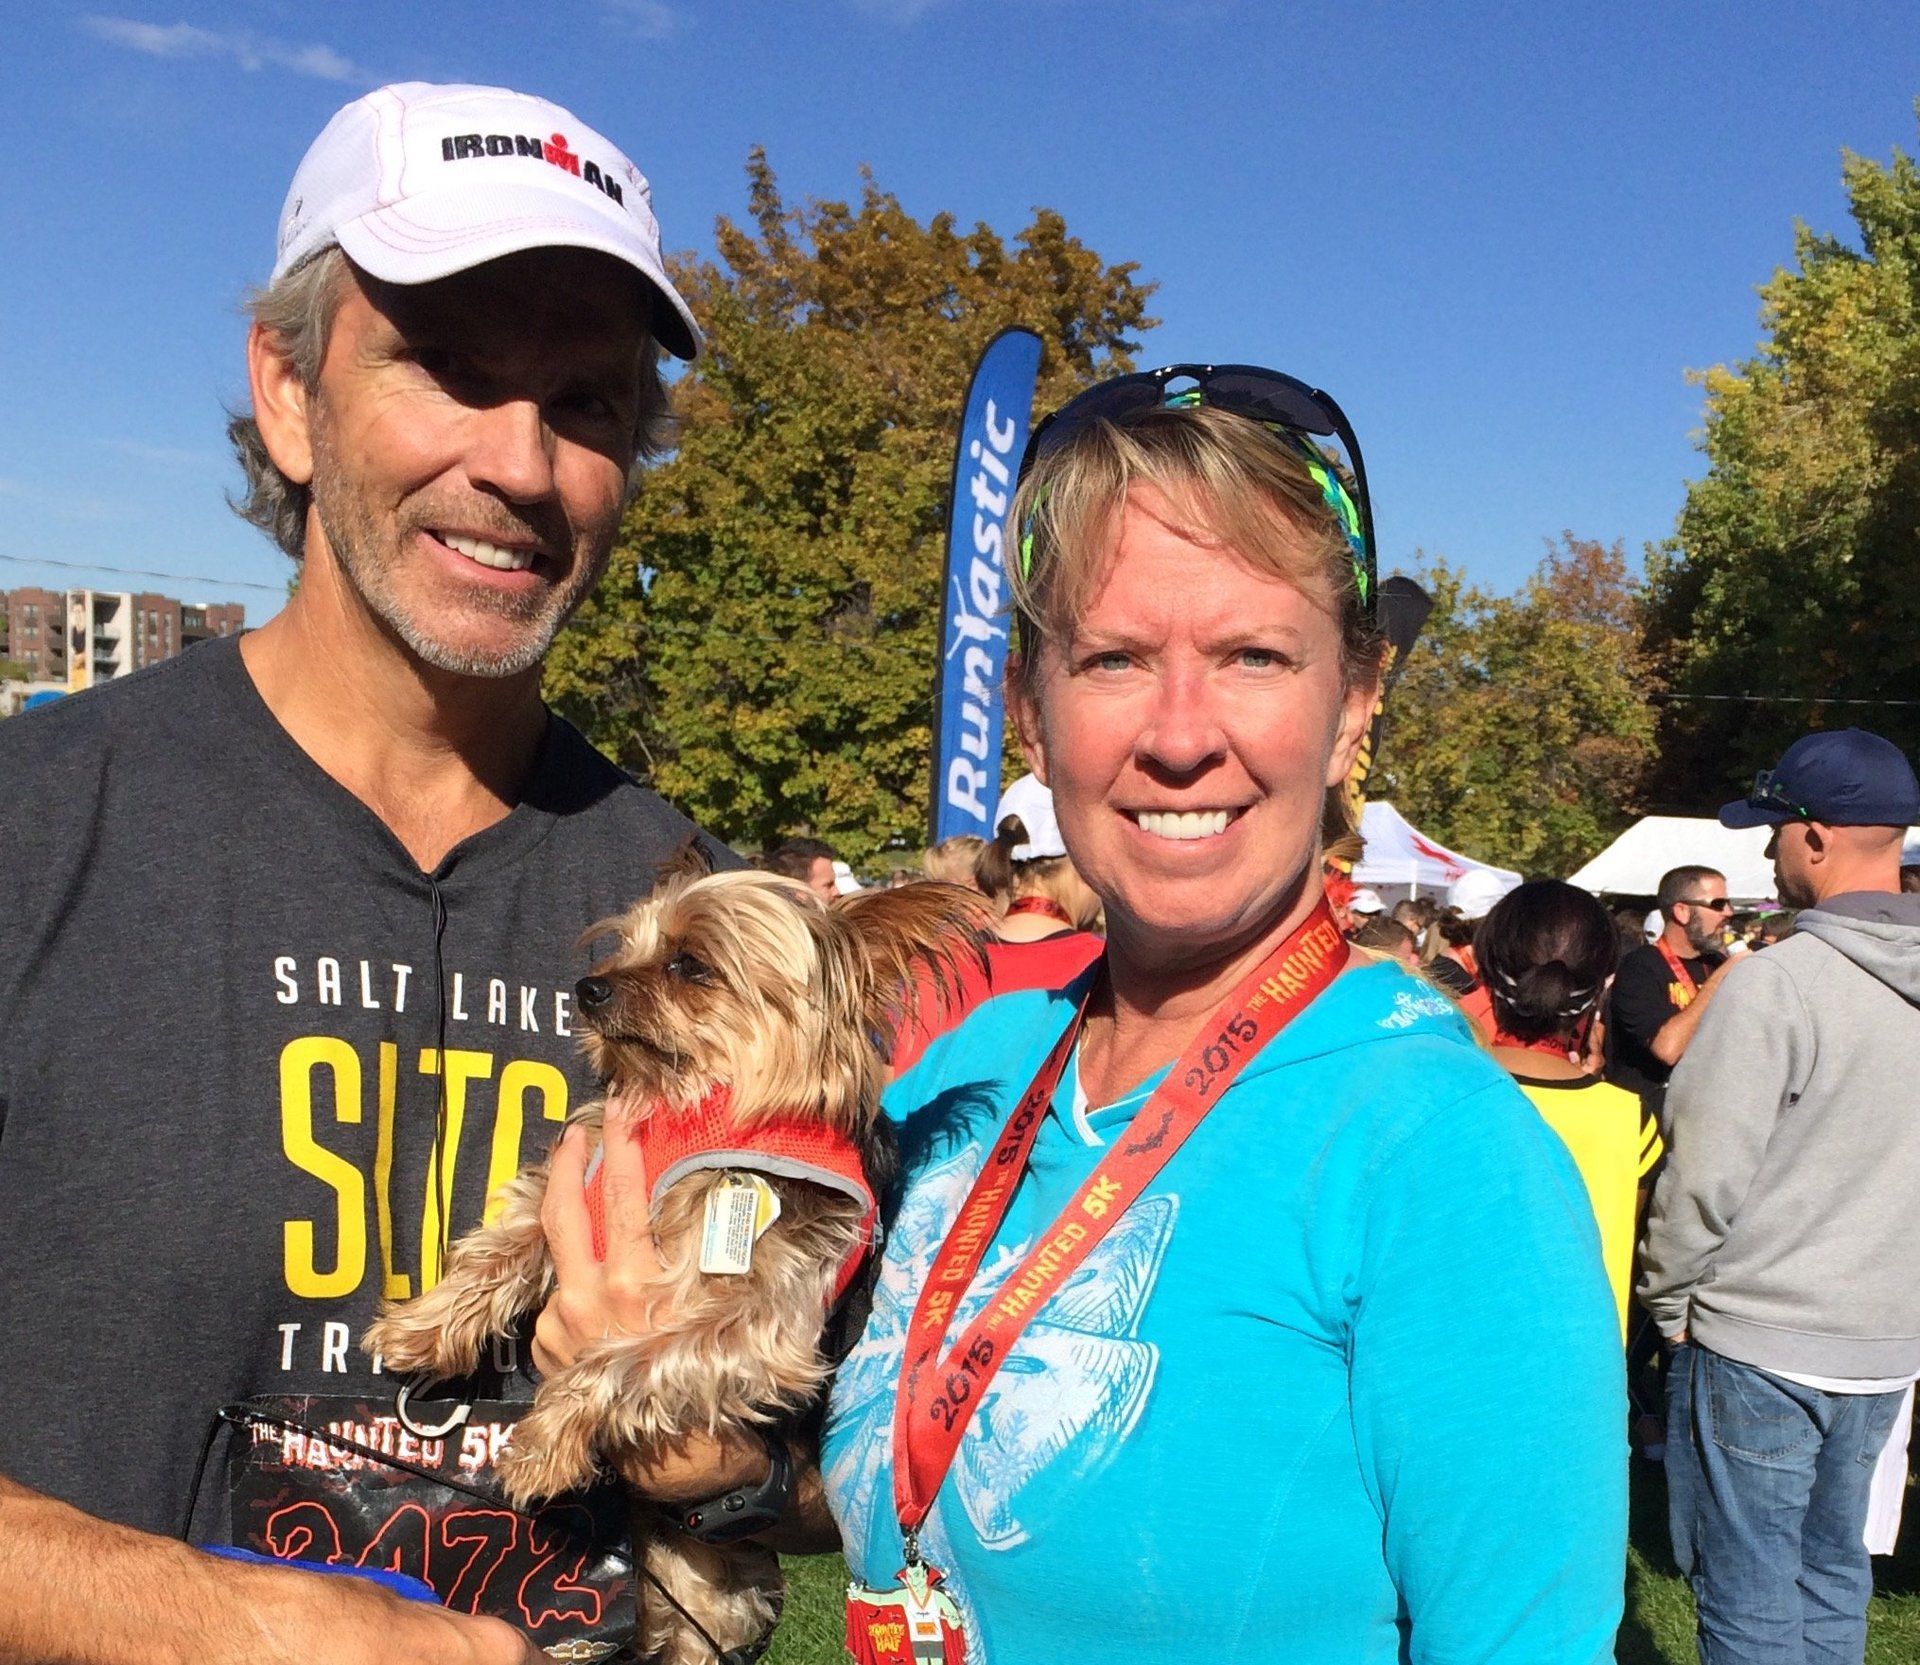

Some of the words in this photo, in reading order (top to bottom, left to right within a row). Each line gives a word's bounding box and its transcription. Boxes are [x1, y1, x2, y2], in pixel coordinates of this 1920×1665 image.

[442, 133, 624, 207] IRONMAN
[275, 956, 412, 1013] SALT
[453, 973, 571, 1037] LAKE
[1185, 1012, 1258, 1096] 2015
[1246, 993, 1269, 1014] THE
[1260, 920, 1340, 1005] HAUNTED
[940, 1187, 1001, 1282] HAUNTED
[924, 1290, 954, 1329] 5K
[930, 1334, 994, 1432] 2015
[985, 1312, 1004, 1332] THE
[999, 1222, 1087, 1318] HAUNTED
[1082, 1174, 1124, 1220] 5K
[250, 1422, 283, 1446] THE
[282, 1417, 444, 1471] HAUNTED
